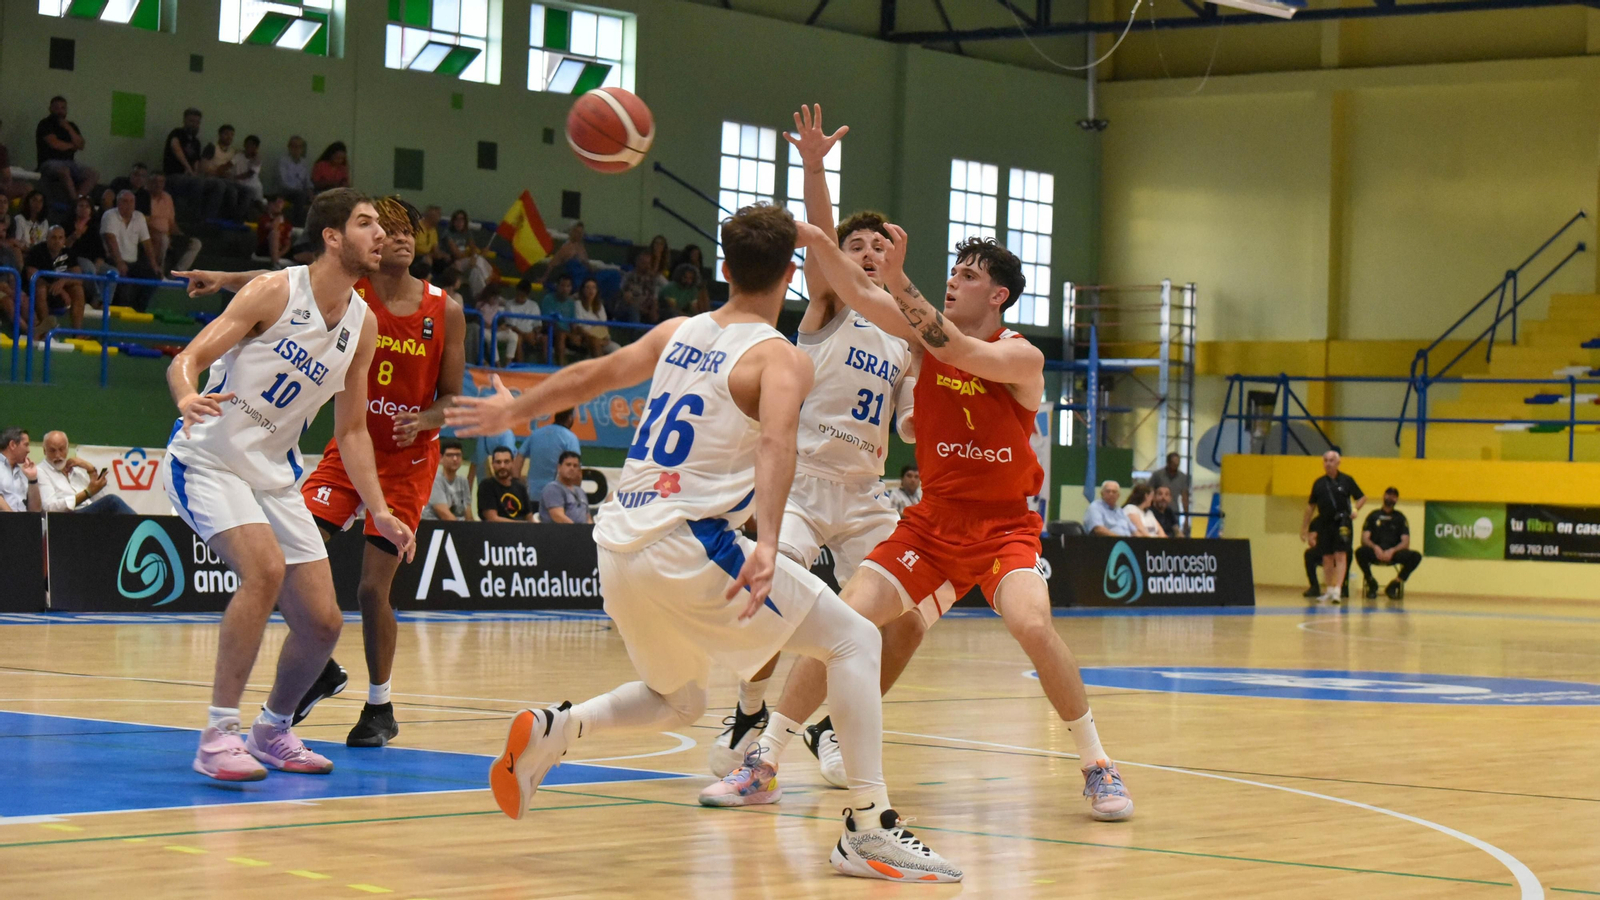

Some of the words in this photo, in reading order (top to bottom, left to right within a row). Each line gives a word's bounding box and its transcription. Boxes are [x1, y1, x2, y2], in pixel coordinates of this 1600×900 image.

[375, 334, 427, 357] SPAÑA
[665, 341, 727, 374] ZIPER
[273, 337, 330, 387] ISRAEL
[377, 360, 394, 386] 8
[260, 372, 302, 409] 10
[229, 395, 263, 424] הפועלים
[851, 388, 884, 426] 31
[260, 417, 277, 434] בנק
[627, 391, 705, 468] 16
[818, 422, 860, 447] הפועלים
[859, 438, 875, 454] בנק
[1510, 517, 1524, 532] tu
[1526, 518, 1555, 533] fibra
[1556, 521, 1573, 535] en
[478, 540, 538, 567] Junta
[1145, 550, 1218, 573] baloncesto
[480, 570, 506, 598] de
[510, 567, 601, 598] Andalucí
